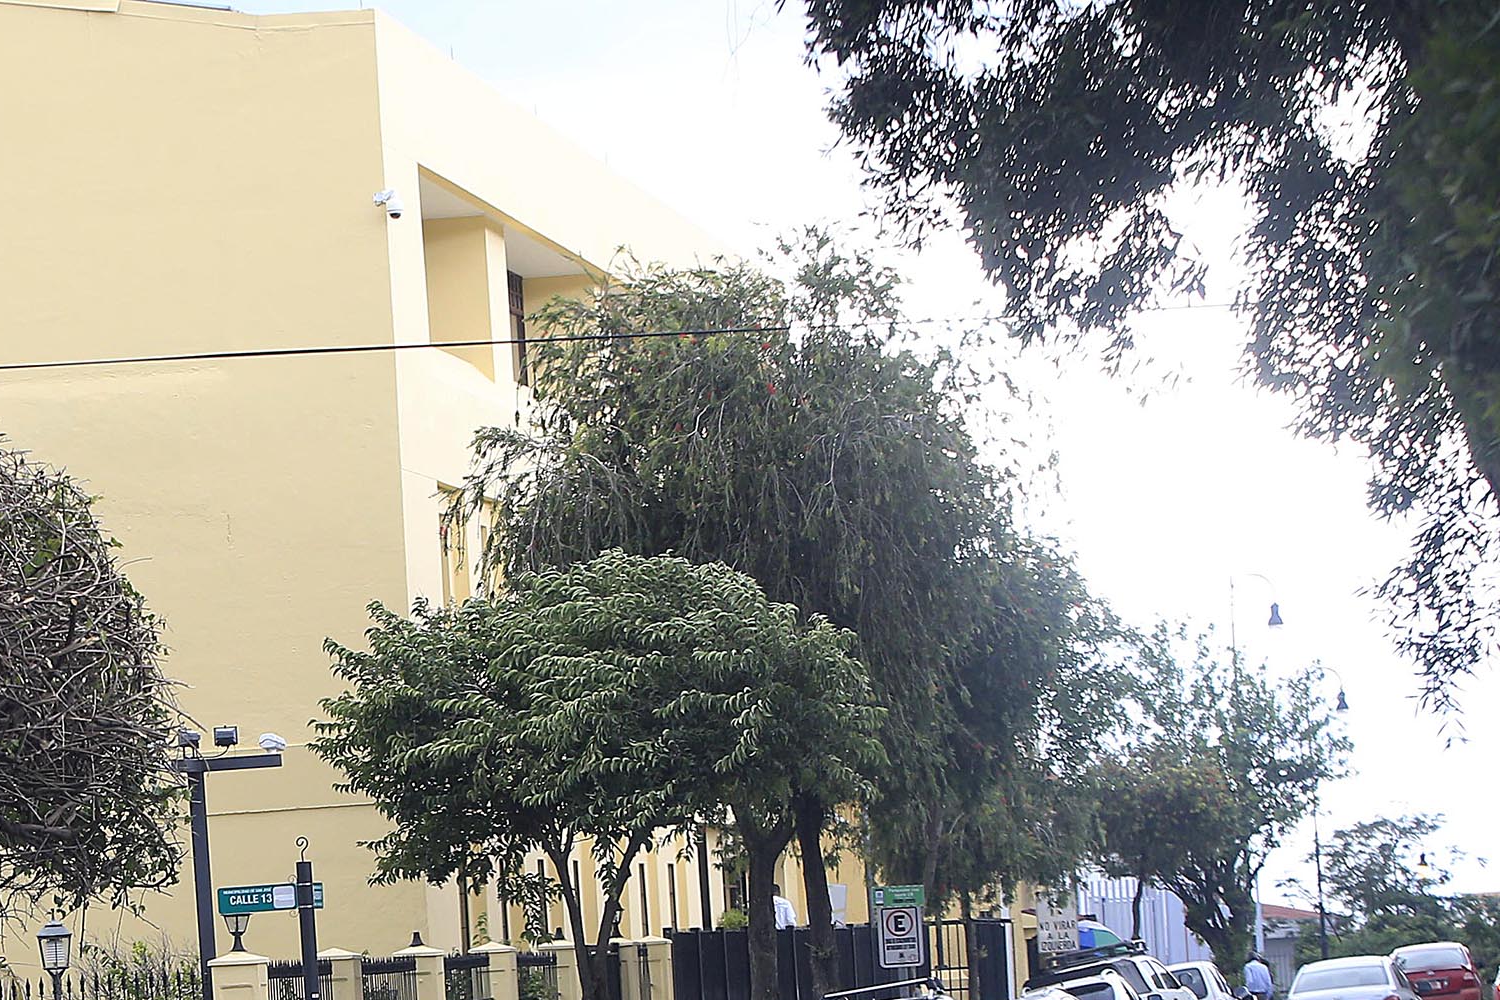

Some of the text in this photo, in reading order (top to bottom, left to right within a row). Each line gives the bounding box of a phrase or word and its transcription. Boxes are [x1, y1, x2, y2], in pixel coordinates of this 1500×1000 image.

[229, 893, 273, 906] CALLE 13
[893, 914, 906, 932] E
[1053, 919, 1077, 930] VIRAR
[1058, 931, 1070, 940] LA
[1041, 940, 1077, 951] IZQUIERDA
